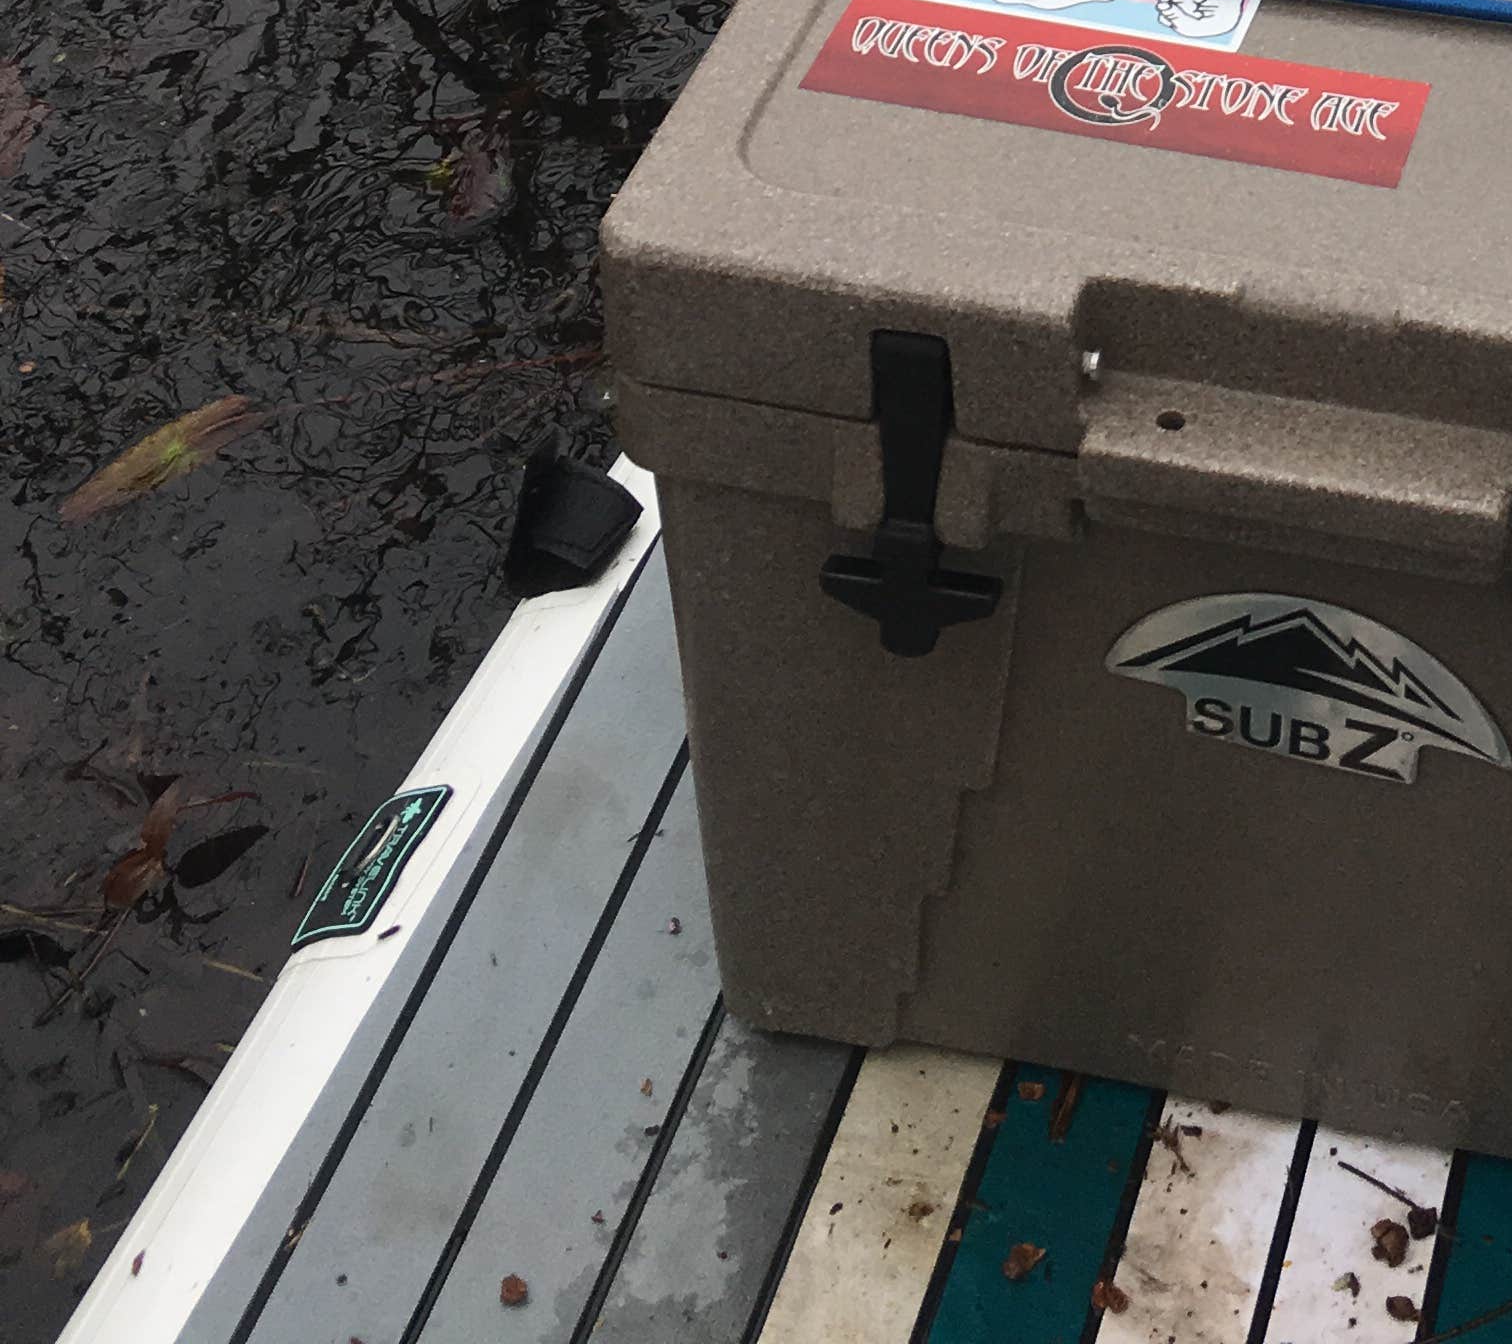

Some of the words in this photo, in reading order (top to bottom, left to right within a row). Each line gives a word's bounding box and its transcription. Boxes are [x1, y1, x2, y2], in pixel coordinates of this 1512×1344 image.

[851, 15, 1008, 75] QUEENS
[1013, 43, 1069, 84] OF
[1083, 52, 1166, 99] THE
[1169, 69, 1309, 127] STONE
[1310, 92, 1400, 142] AGE
